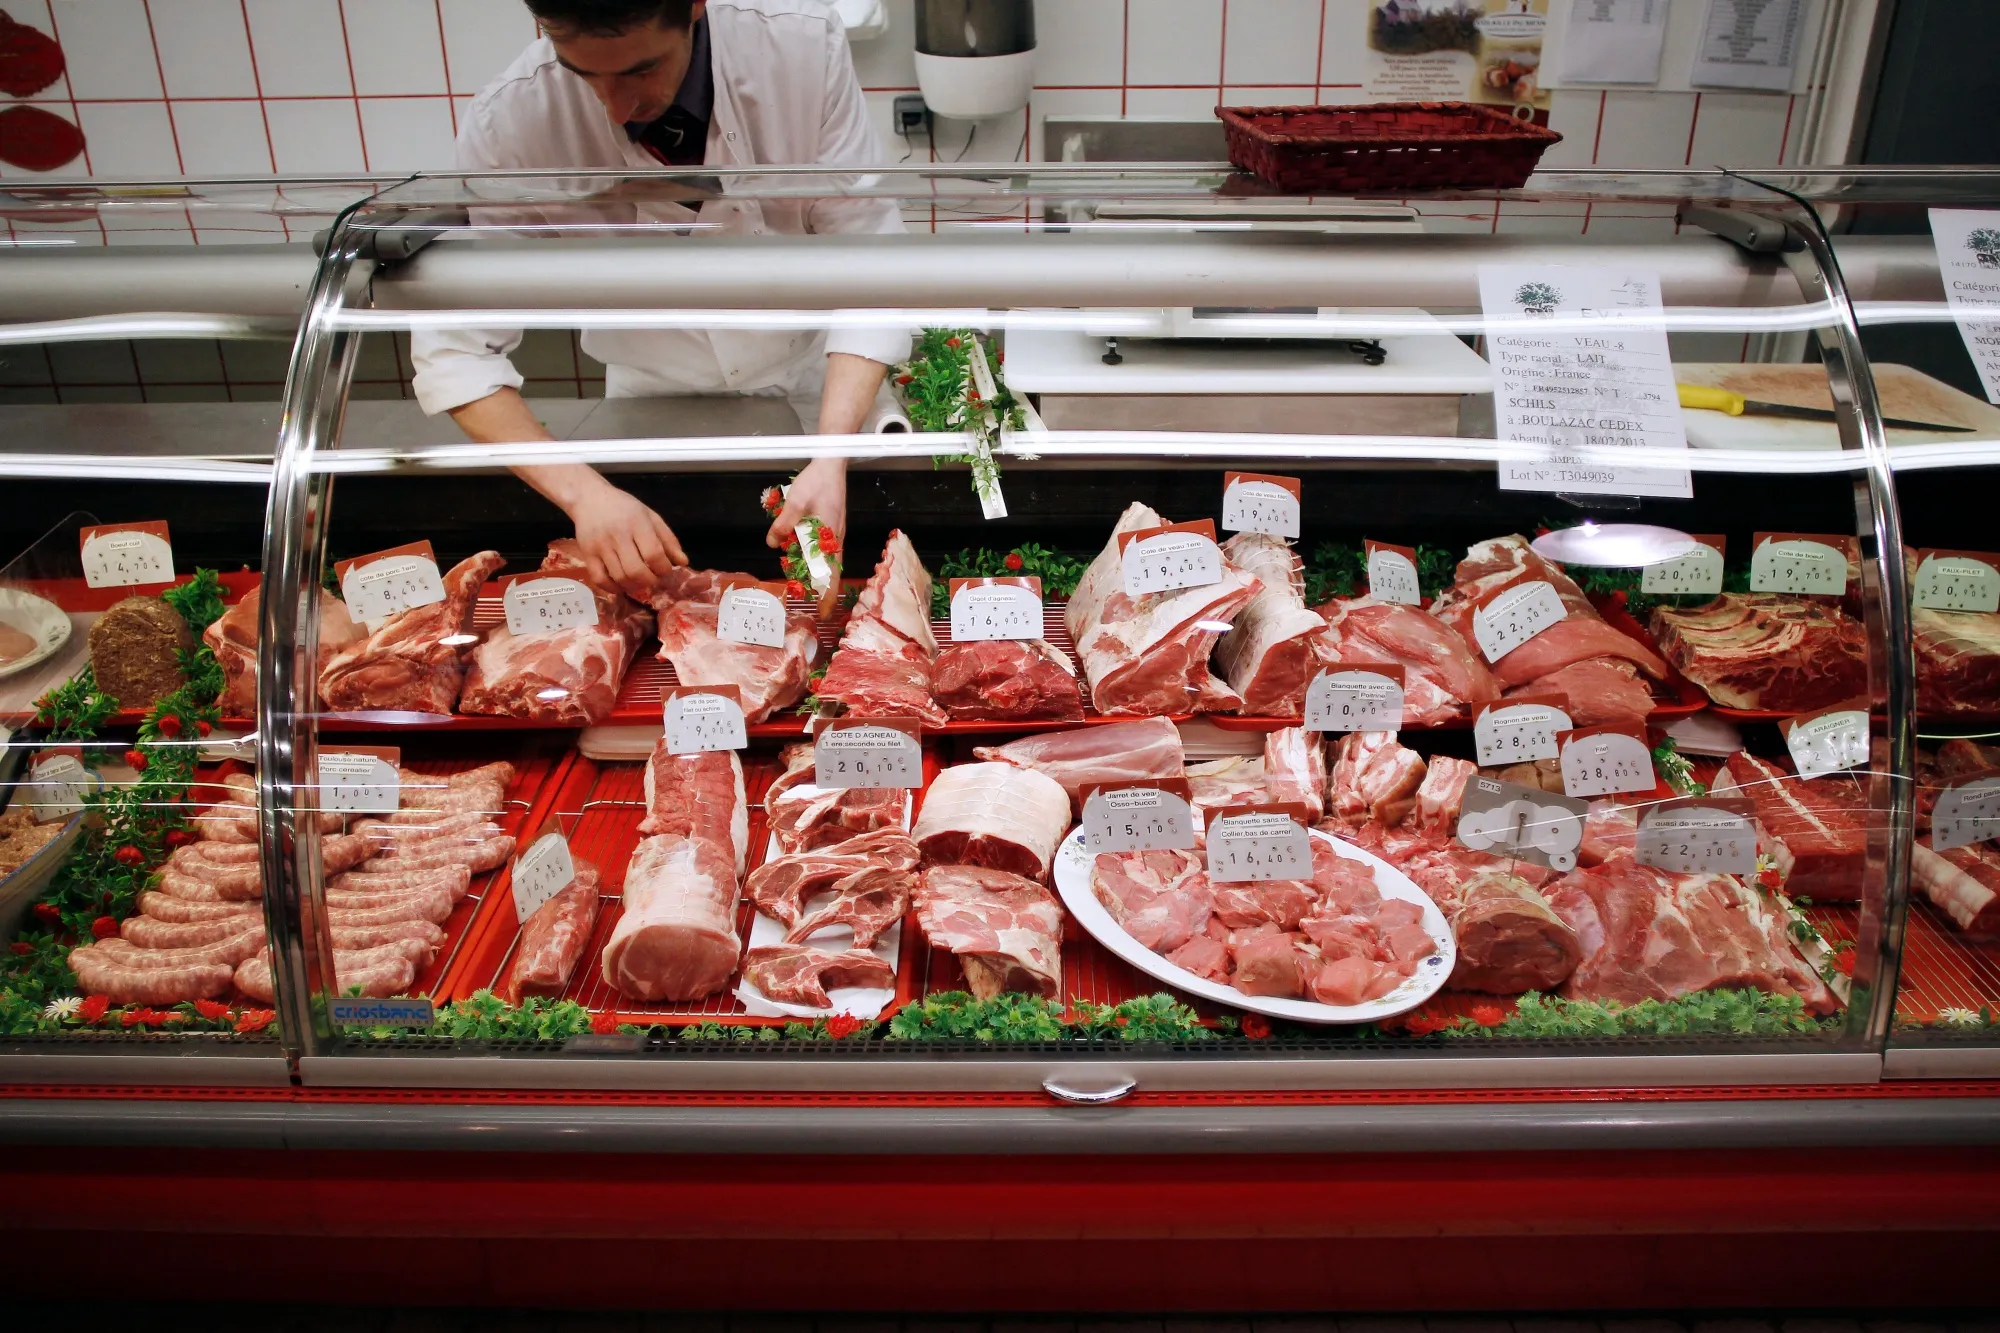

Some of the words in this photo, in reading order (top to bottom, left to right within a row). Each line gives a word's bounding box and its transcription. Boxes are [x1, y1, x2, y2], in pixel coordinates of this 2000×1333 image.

[1497, 336, 1551, 349] Catégorie
[1574, 337, 1610, 349] VEAU
[1499, 351, 1528, 363] Type
[1531, 354, 1562, 364] racial
[1577, 354, 1607, 364] LAIT
[1502, 366, 1545, 378] Origine
[1509, 397, 1556, 410] SCHILS
[1599, 419, 1644, 432] CEDEX
[1552, 435, 1562, 446] le
[1584, 435, 1646, 447] 18/02/2013
[1510, 469, 1531, 480] Lot
[1559, 470, 1615, 483] T3049039
[971, 616, 1018, 628] 16,90
[1497, 611, 1539, 641] 22,30
[1494, 718, 1520, 726] Rognon
[1814, 718, 1851, 734] ARAIGNER
[1496, 736, 1546, 750] 28,50
[319, 755, 352, 763] Toulouse
[838, 761, 892, 775] 20,10
[1581, 767, 1628, 781] 28,80
[1480, 781, 1501, 793] 5713
[1110, 800, 1157, 808] Osso-bucco
[1963, 793, 1982, 802] Rond
[1223, 818, 1261, 827] Blanquette
[1107, 824, 1163, 837] 15,10
[1660, 843, 1723, 859] 22,30
[1230, 851, 1283, 866] 16,40
